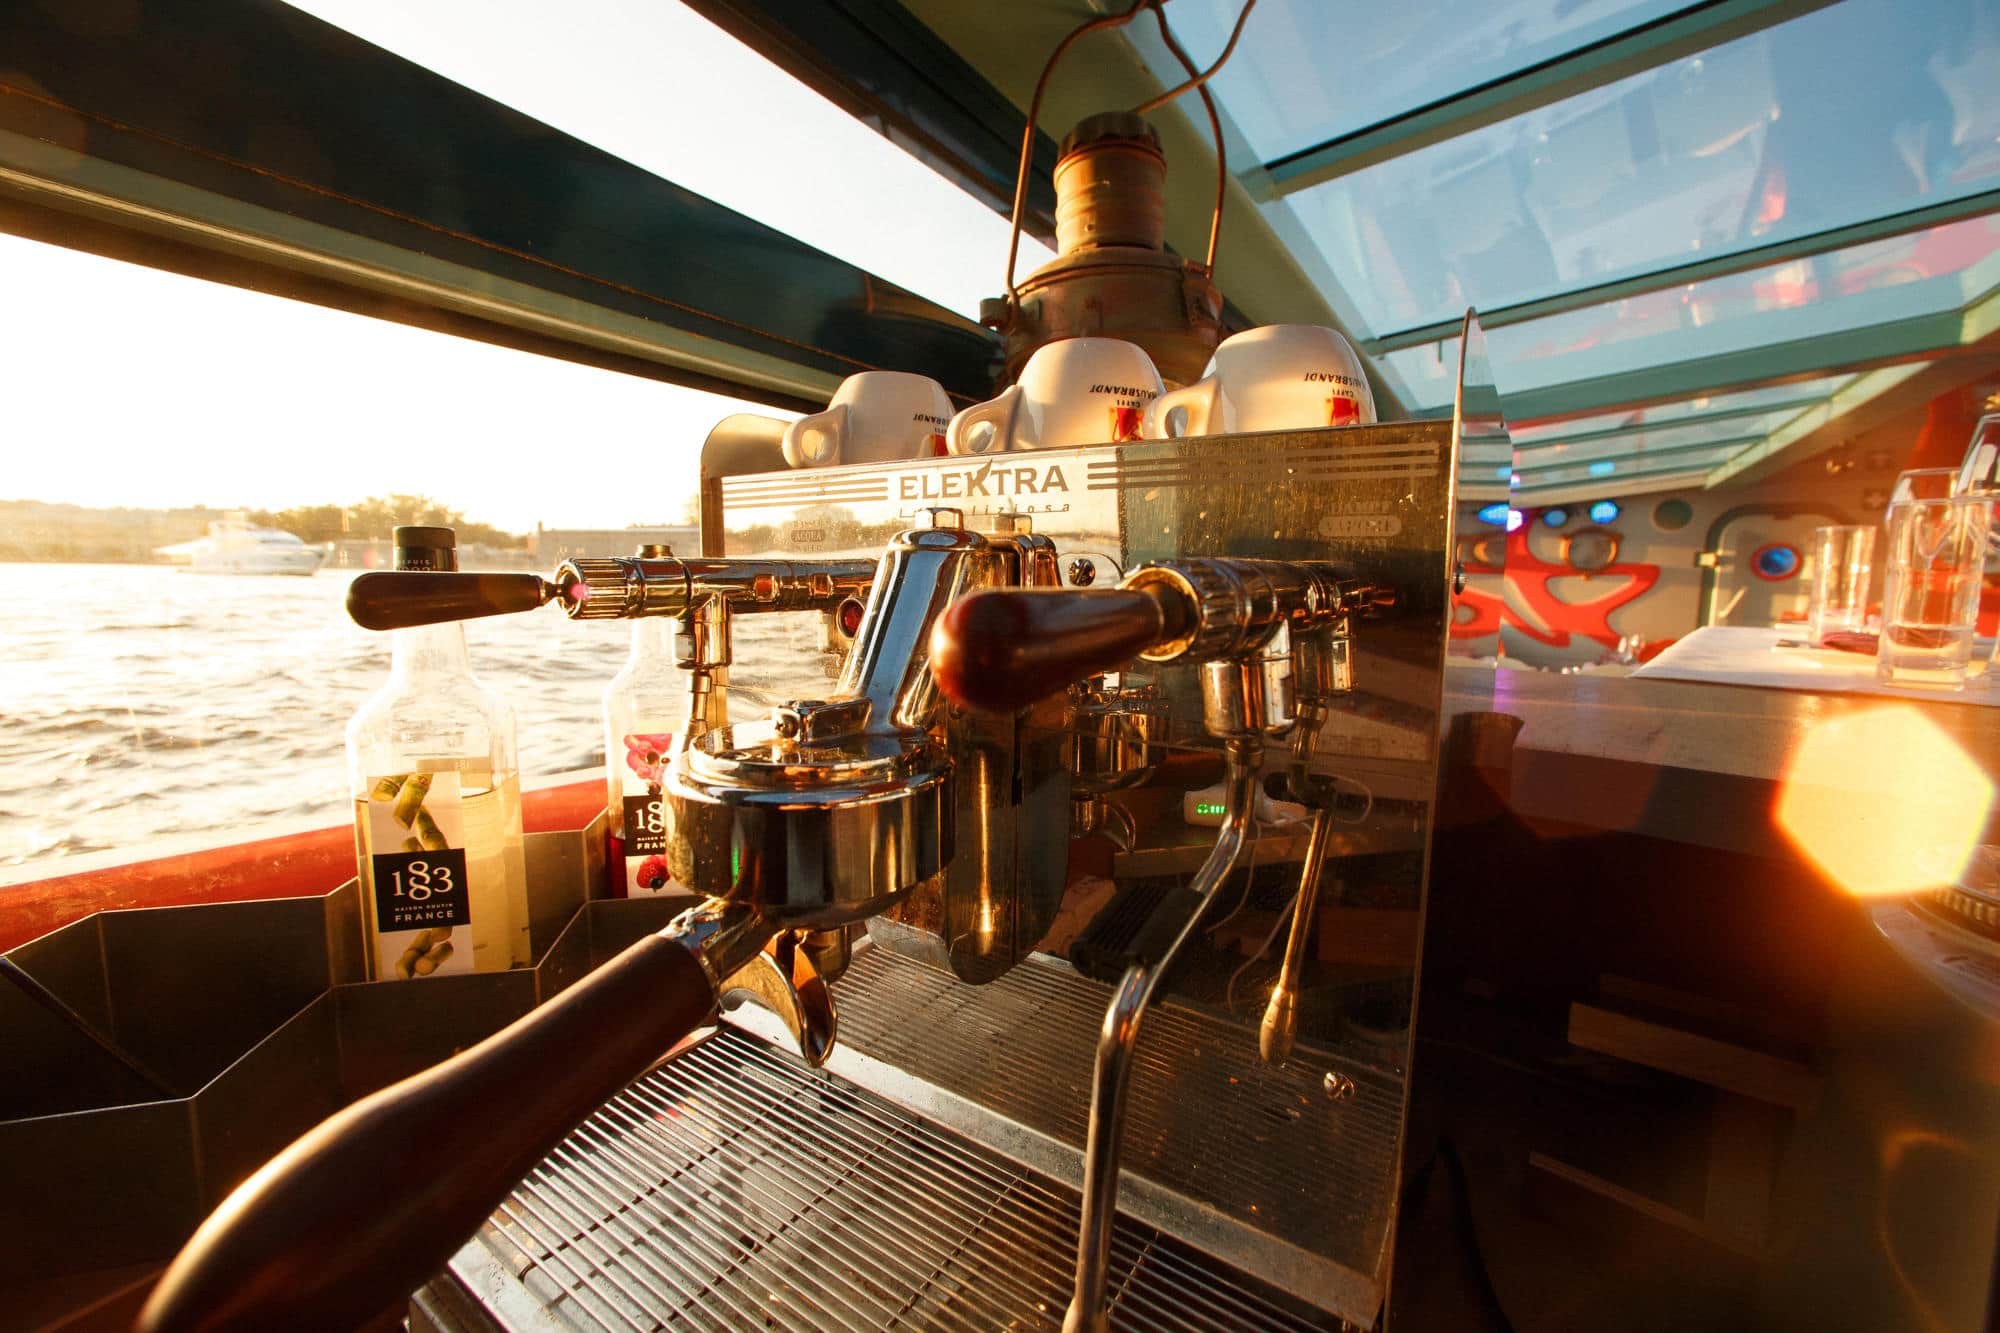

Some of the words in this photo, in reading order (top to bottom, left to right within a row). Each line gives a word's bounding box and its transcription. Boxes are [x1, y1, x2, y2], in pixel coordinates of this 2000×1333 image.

[913, 413, 946, 425] BRANDT
[899, 459, 1069, 501] ELEKTRA
[637, 842, 666, 850] FRAN
[394, 910, 454, 923] FRANCE
